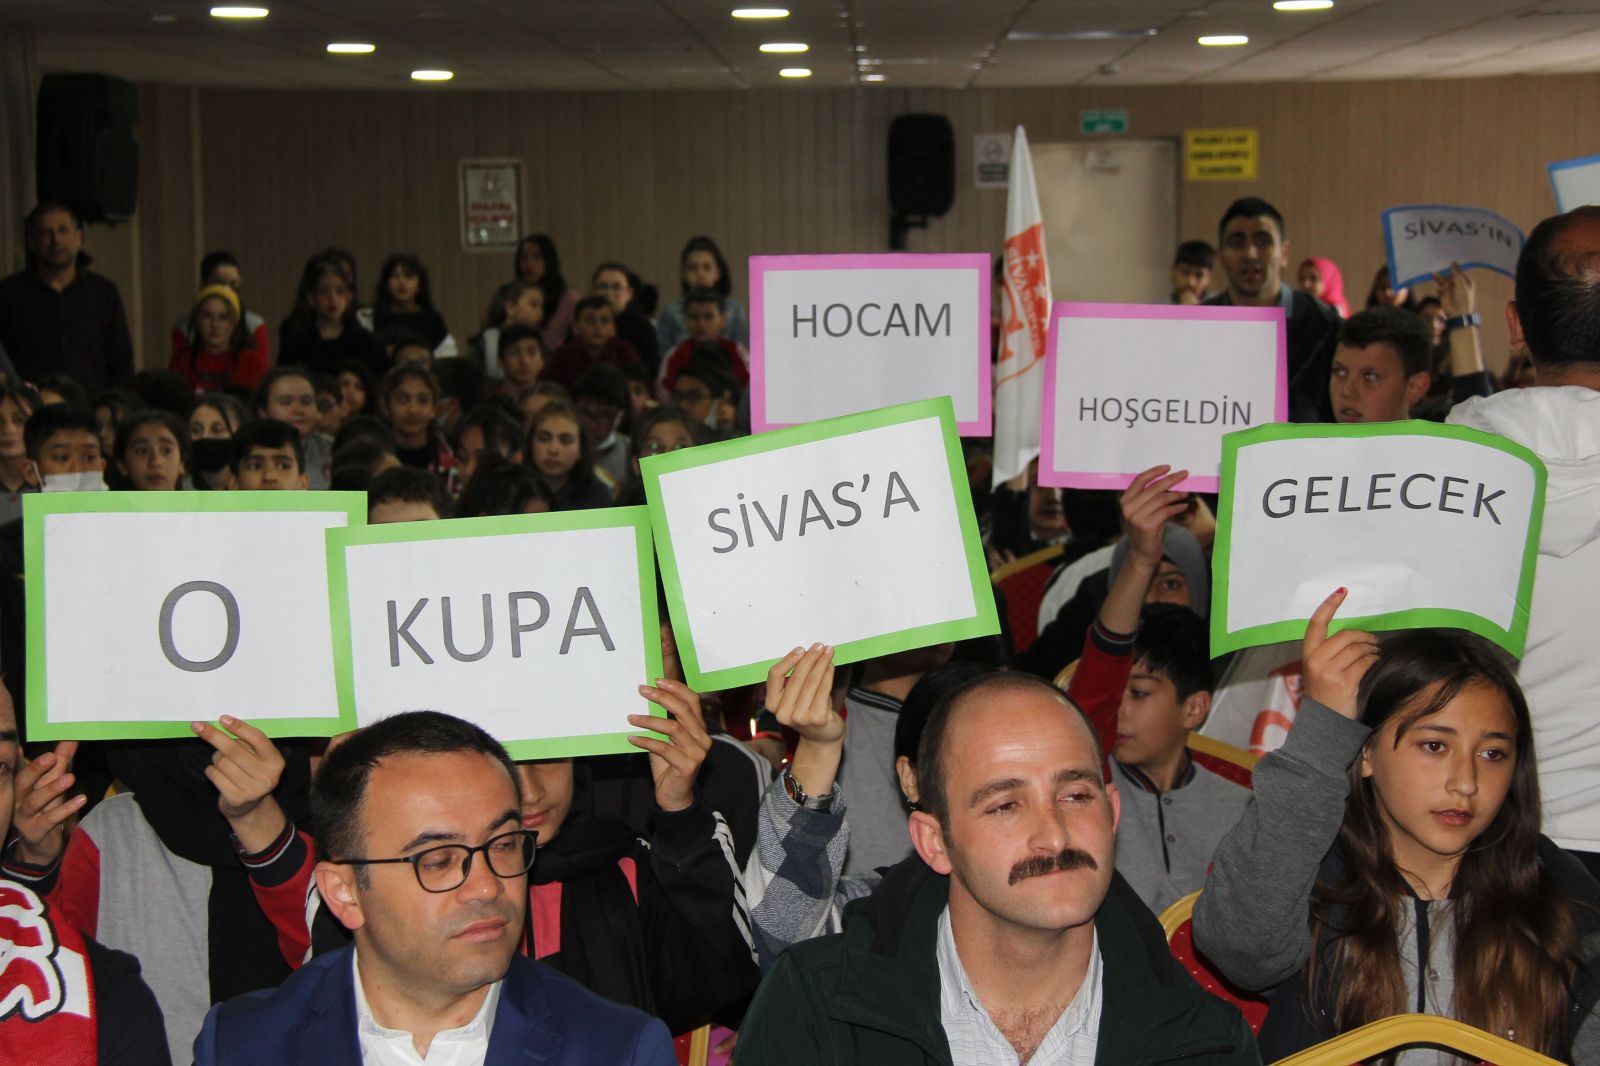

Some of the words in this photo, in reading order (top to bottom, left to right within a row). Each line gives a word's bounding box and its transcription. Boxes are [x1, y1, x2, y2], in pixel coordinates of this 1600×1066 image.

[793, 302, 950, 339] HOCAM
[1079, 395, 1252, 428] HOŞGELDİN
[1262, 473, 1506, 525] GELECEK
[158, 580, 241, 673] O
[386, 586, 616, 668] KUPA
